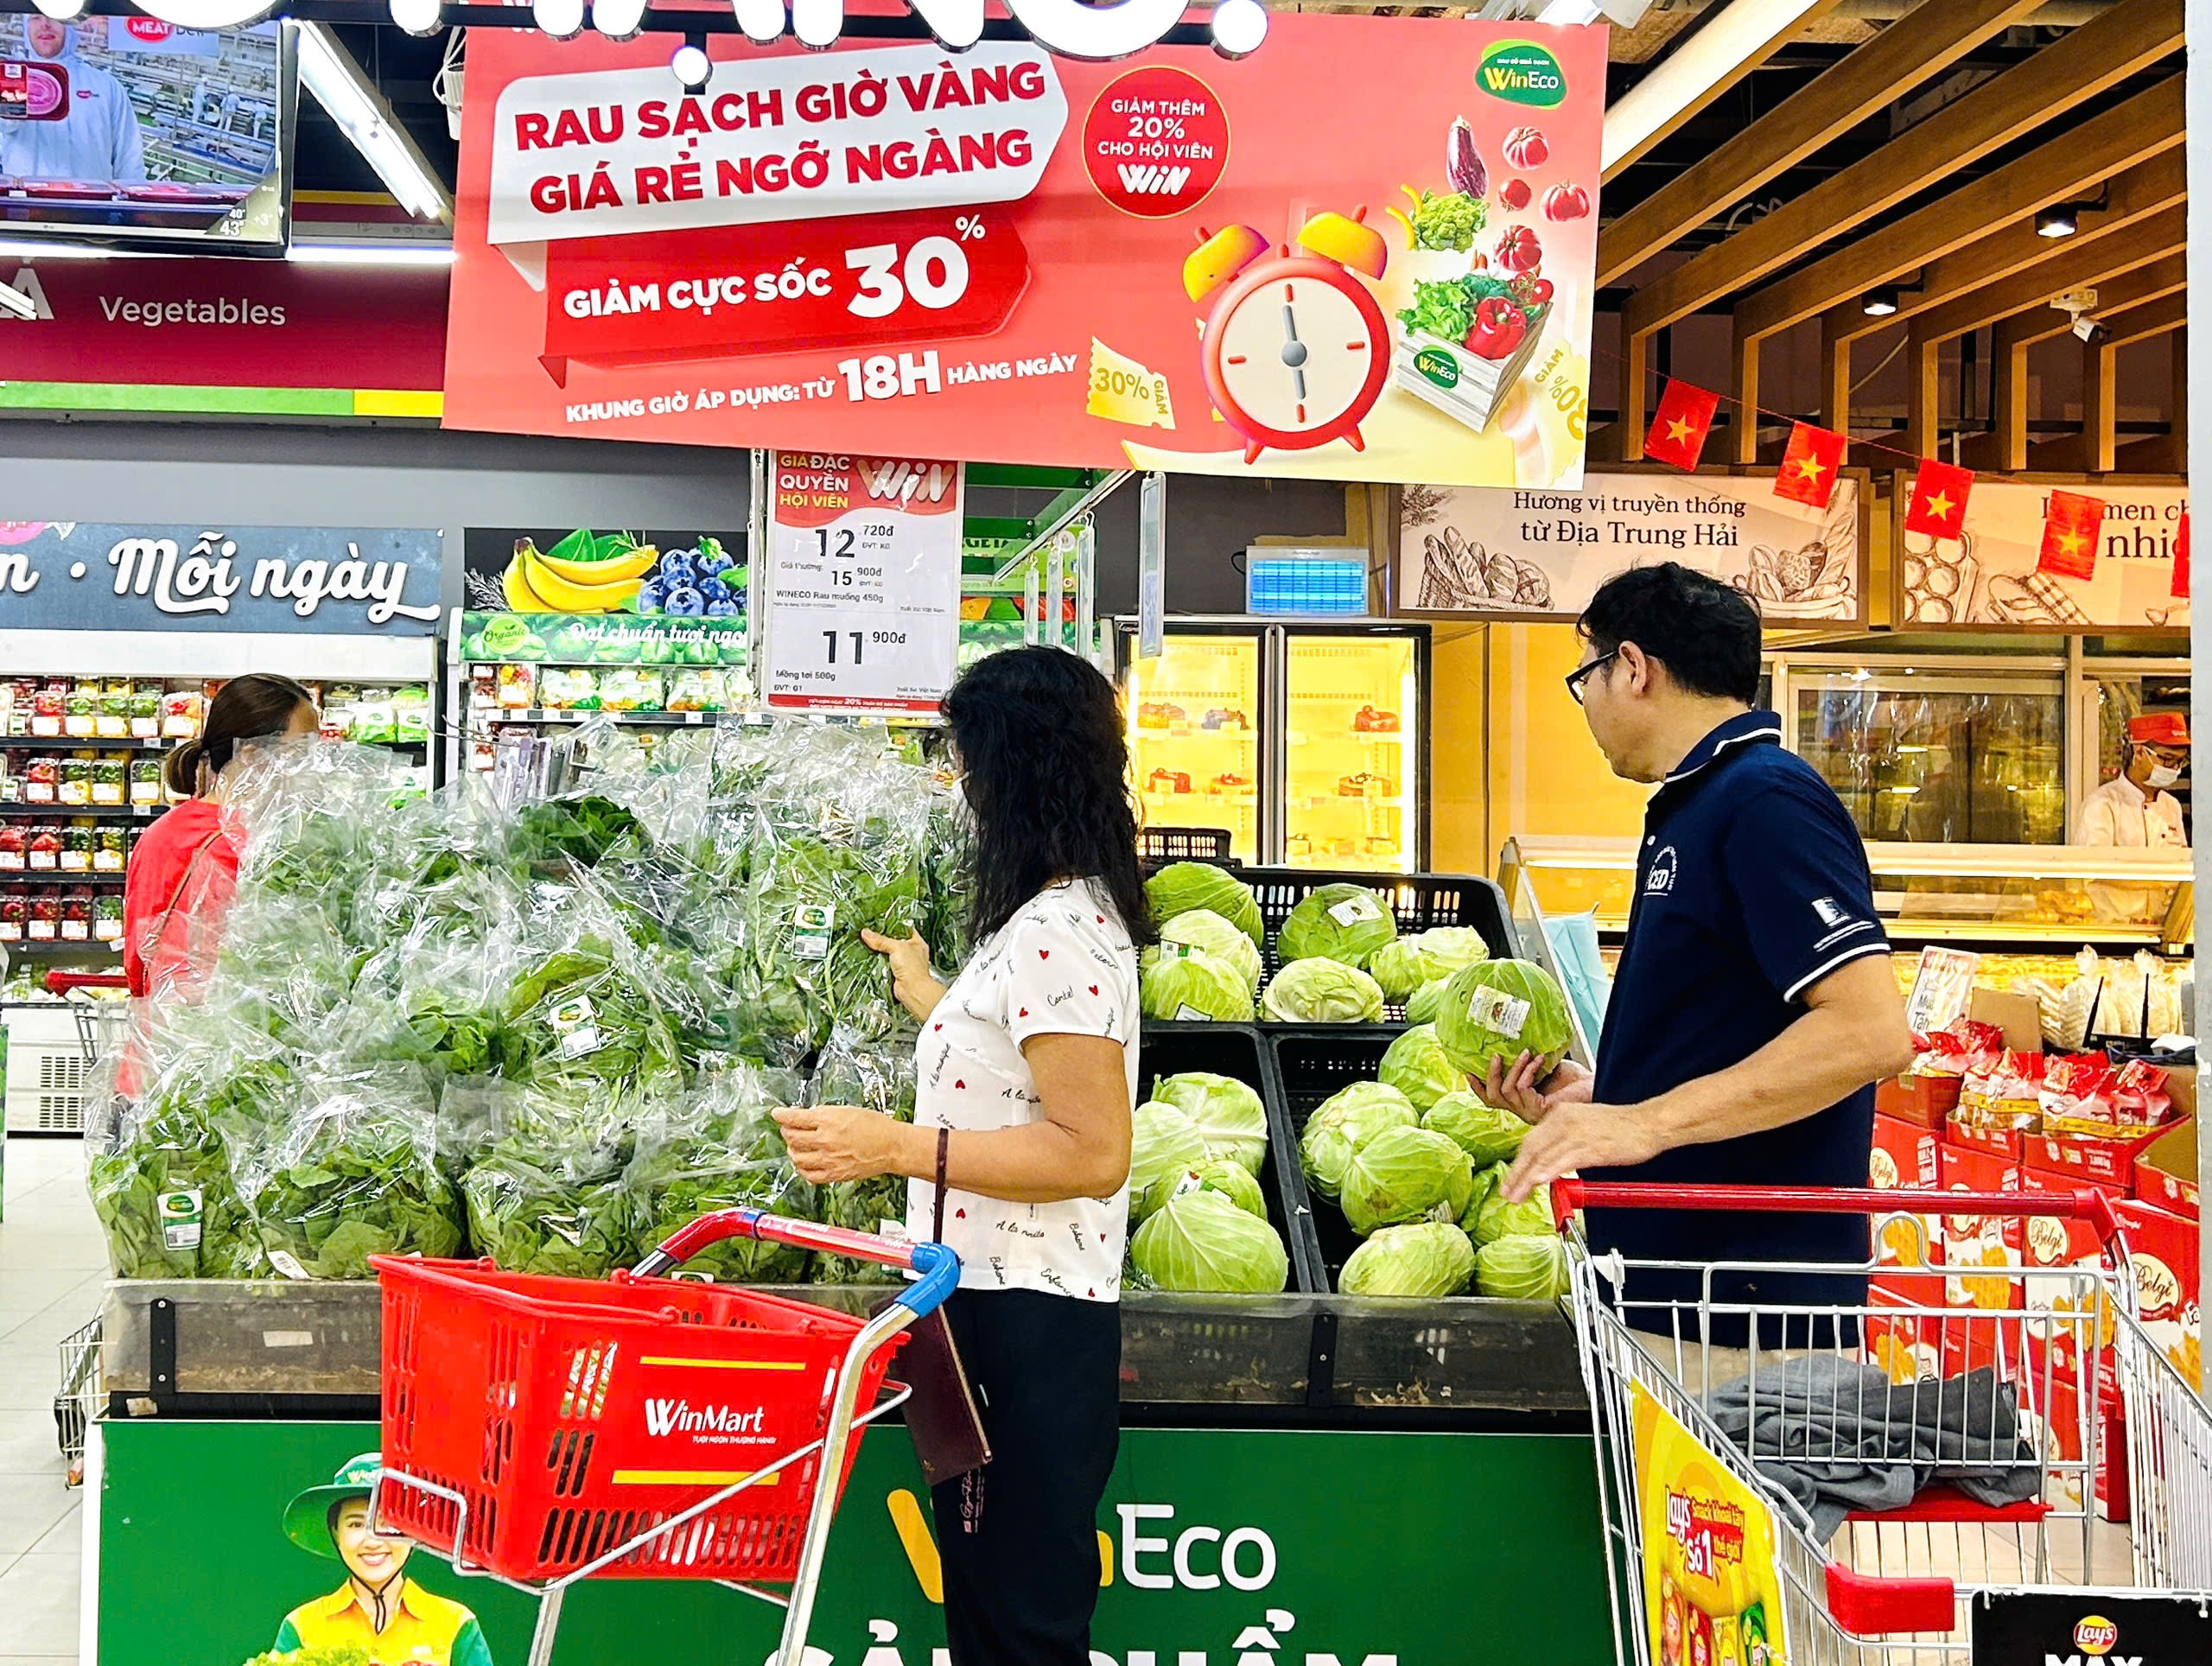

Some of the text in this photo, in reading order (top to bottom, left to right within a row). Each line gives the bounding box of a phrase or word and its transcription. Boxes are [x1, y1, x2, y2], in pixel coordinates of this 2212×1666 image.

[132, 20, 170, 35] MEAT
[1484, 67, 1560, 90] WinEco
[515, 61, 1045, 151] RAU SẠCH GIỜ VÀNG
[1111, 96, 1205, 116] GIẢM THÊM
[1128, 116, 1185, 139] 20%
[1098, 140, 1213, 160] CHO HỘI VIÊN
[530, 129, 1032, 214] GIÁ RẺ NGỠ NGÀNG
[564, 283, 660, 319] GIẢM
[667, 277, 746, 315] CỰC
[754, 257, 832, 301] SỐC
[99, 296, 286, 327] Vegetables
[1419, 356, 1456, 381] WinEco
[566, 350, 1078, 423] KHUNG GIỜ ÁP DỤNG: TỪ 18H HÀNG NGÀY
[1095, 368, 1150, 400] 30%
[780, 454, 850, 472] GIÁ ĐẶC
[779, 472, 849, 492] QUYỀN
[779, 493, 849, 510] HỘI VIÊN
[1514, 492, 1746, 518] Hương vị truyền thống
[815, 529, 855, 558] 12
[1521, 519, 1738, 548] từ Địa Trung Hải
[108, 531, 241, 614] Mỗi
[250, 542, 442, 624] ngày
[831, 570, 853, 586] 15
[776, 590, 884, 603] WINECO Rau muống 450g
[484, 627, 526, 643] Organic
[823, 630, 906, 664] 11 900đ
[815, 671, 836, 682] 500g
[844, 697, 862, 706] 20%
[645, 1398, 765, 1436] WinMart
